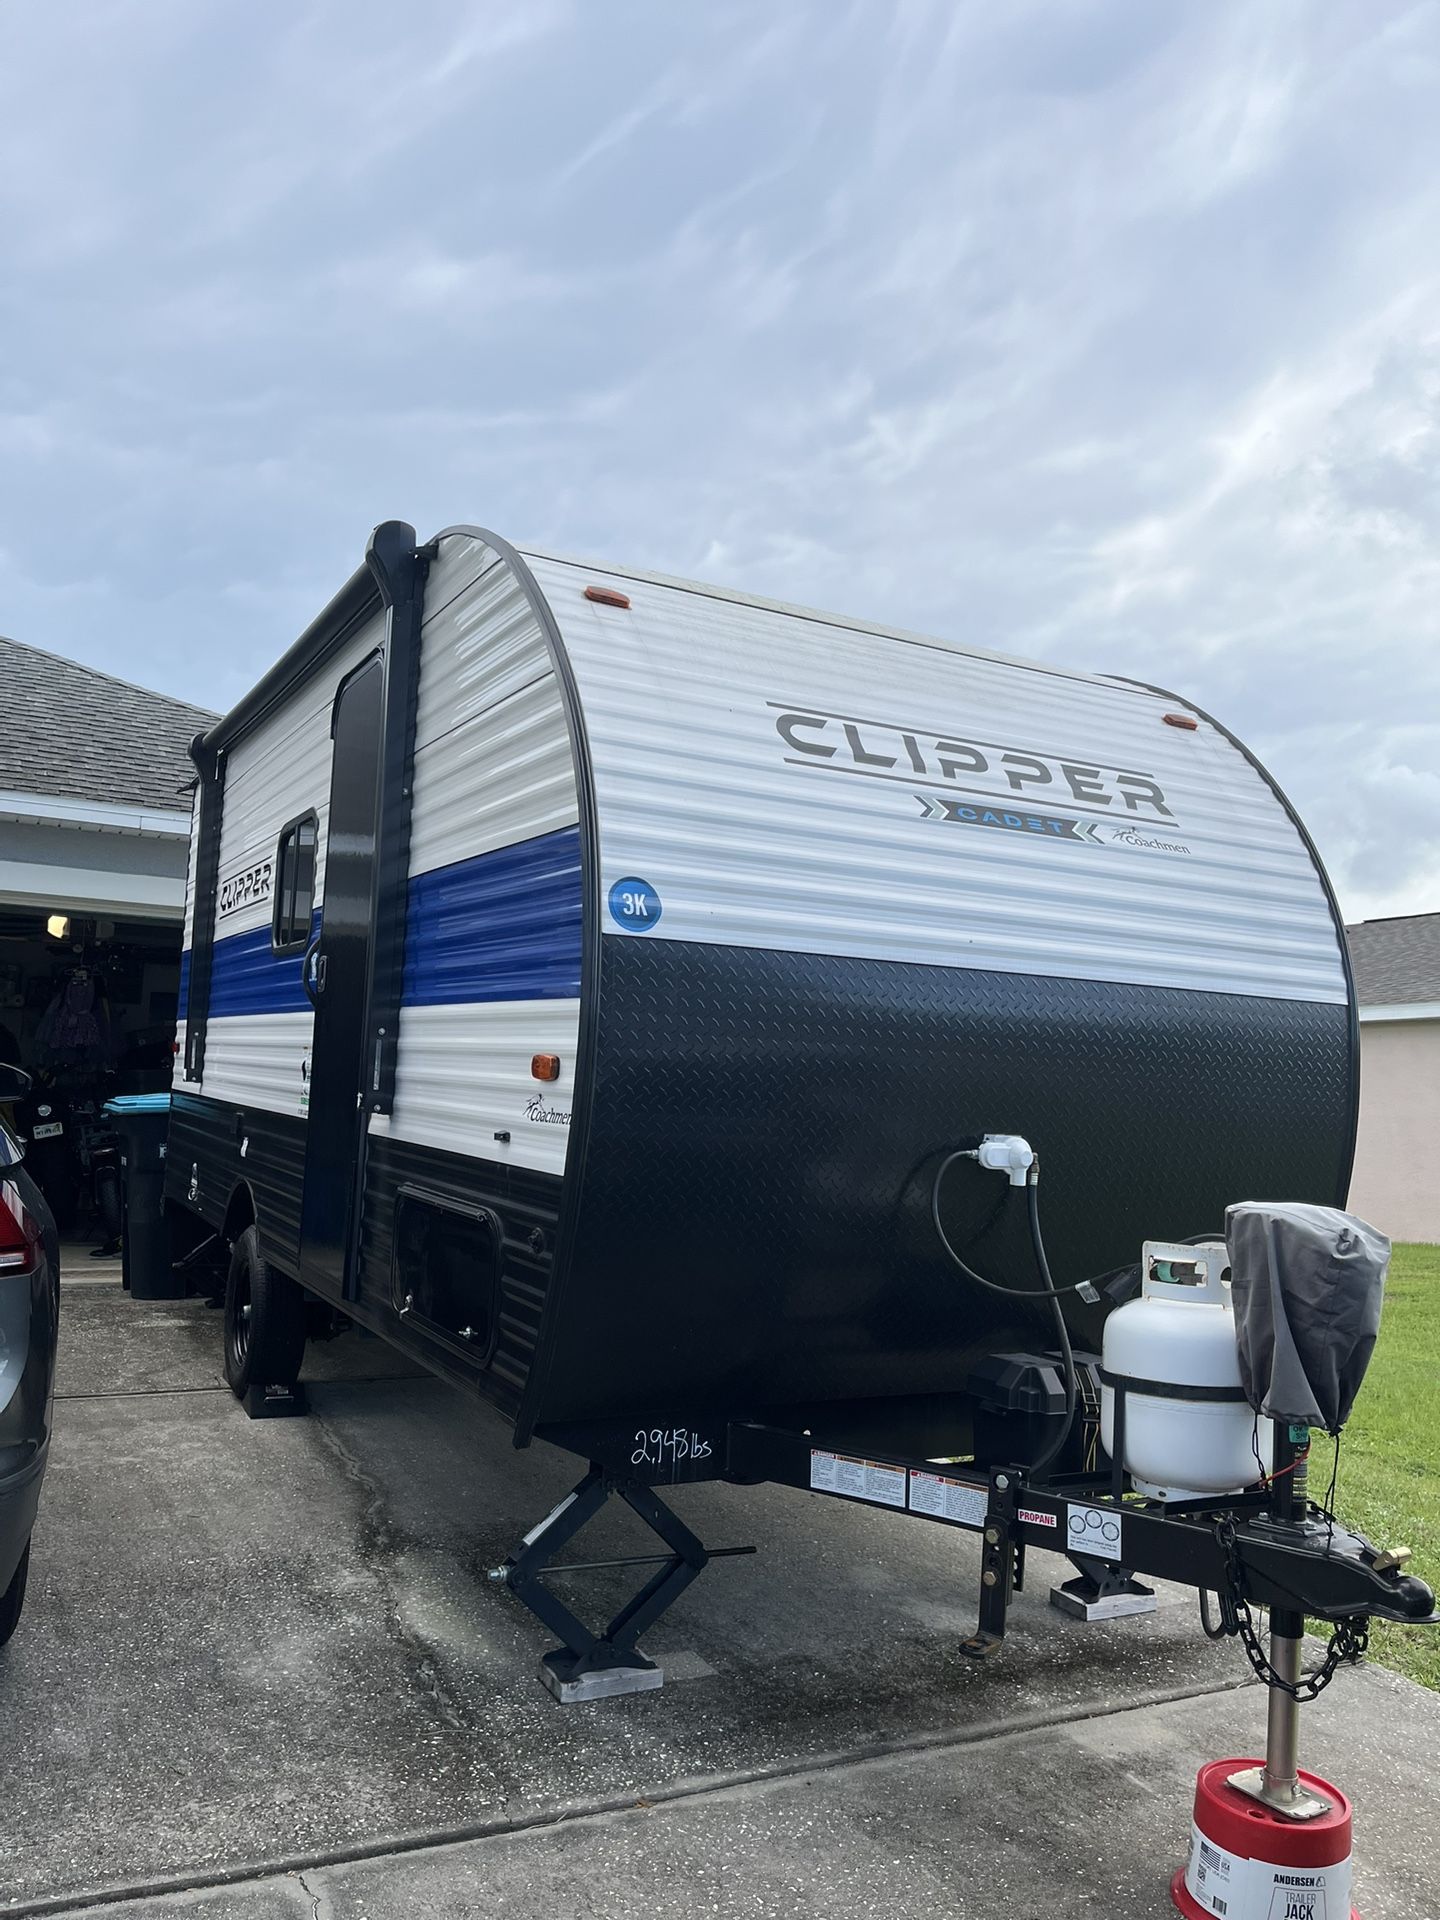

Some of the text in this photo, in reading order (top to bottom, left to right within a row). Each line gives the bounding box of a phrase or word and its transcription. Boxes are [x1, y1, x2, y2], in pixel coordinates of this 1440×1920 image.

[776, 713, 1175, 816] CLIPPER
[956, 806, 1063, 834] CADET
[1125, 834, 1191, 855] Coachmen
[220, 863, 271, 911] CLIPPER
[622, 892, 648, 916] 3K
[530, 1107, 573, 1125] Coachmen
[1019, 1511, 1055, 1526] PROPANE
[1273, 1874, 1315, 1887] ANDERSEN
[1285, 1892, 1317, 1905] TRAILER
[1284, 1904, 1314, 1920] JACK
